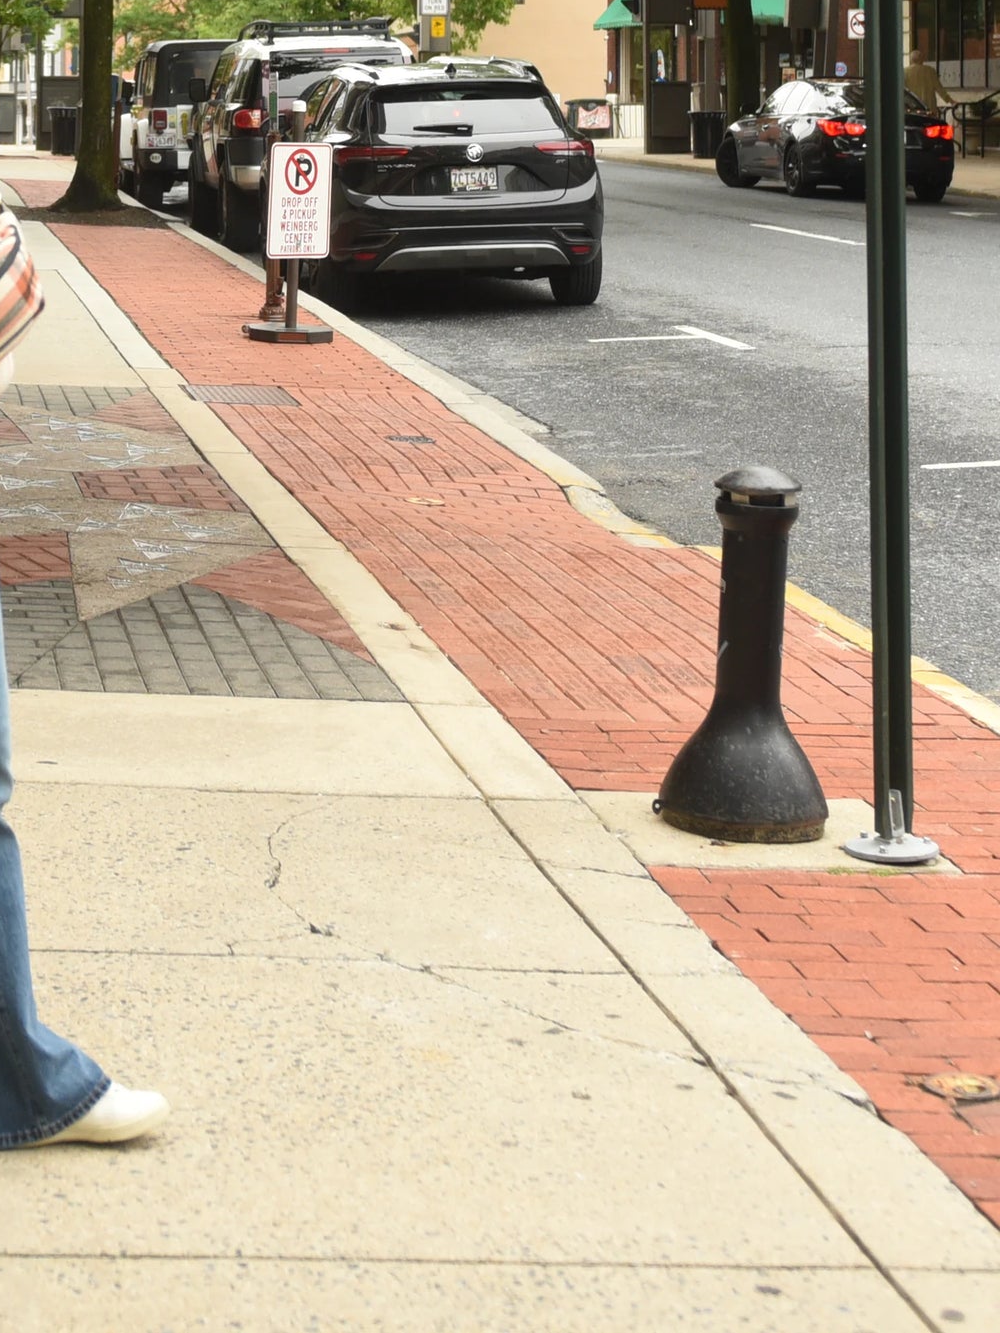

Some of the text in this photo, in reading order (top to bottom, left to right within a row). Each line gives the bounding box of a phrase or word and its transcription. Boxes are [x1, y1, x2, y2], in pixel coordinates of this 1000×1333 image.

[281, 197, 319, 208] DROP OFF
[282, 209, 317, 220] & PICKUP
[280, 220, 319, 232] WEINBERG
[284, 233, 313, 243] CENTER
